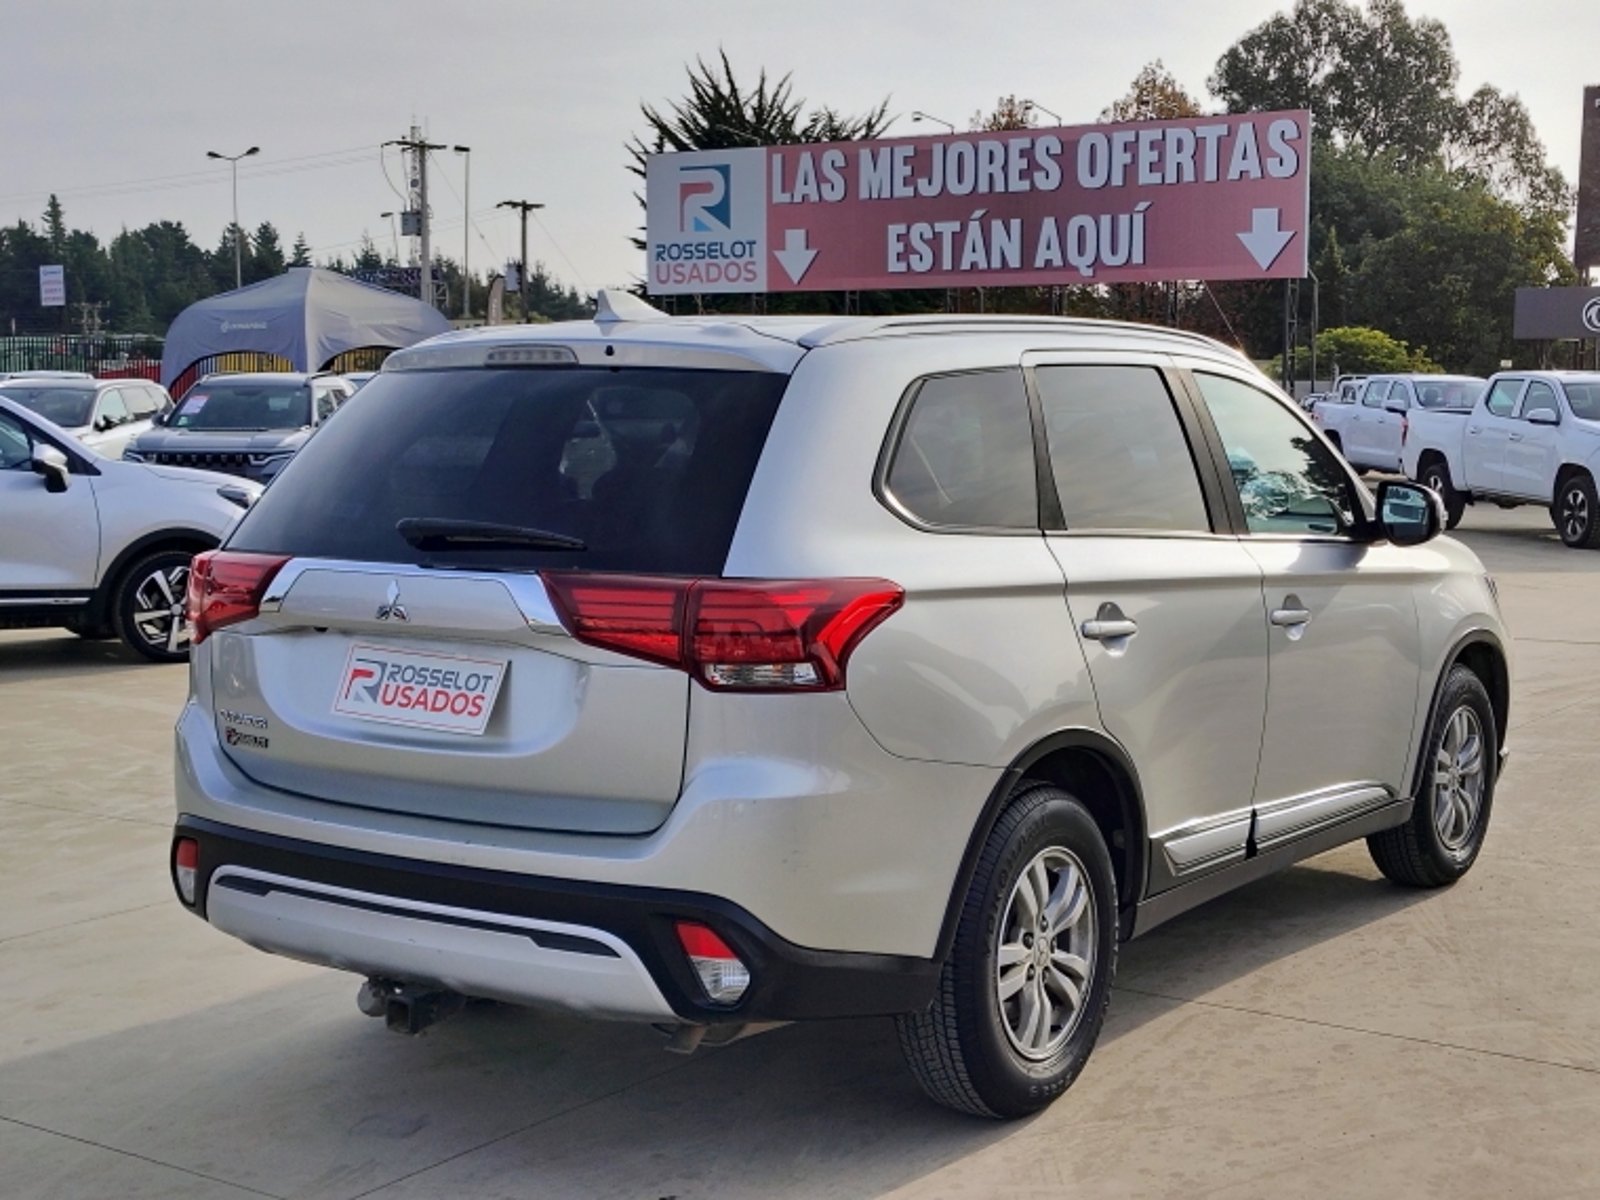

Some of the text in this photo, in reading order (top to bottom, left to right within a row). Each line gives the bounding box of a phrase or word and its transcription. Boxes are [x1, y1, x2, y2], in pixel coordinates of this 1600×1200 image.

[772, 119, 1301, 204] LAS MEJORES OFERTAS
[655, 240, 757, 261] ROSSELOT
[887, 201, 1153, 277] ESTÁN AQUÍ
[656, 261, 757, 285] USADOS
[387, 664, 493, 693] ROSSELOT
[381, 684, 485, 717] USADOS
